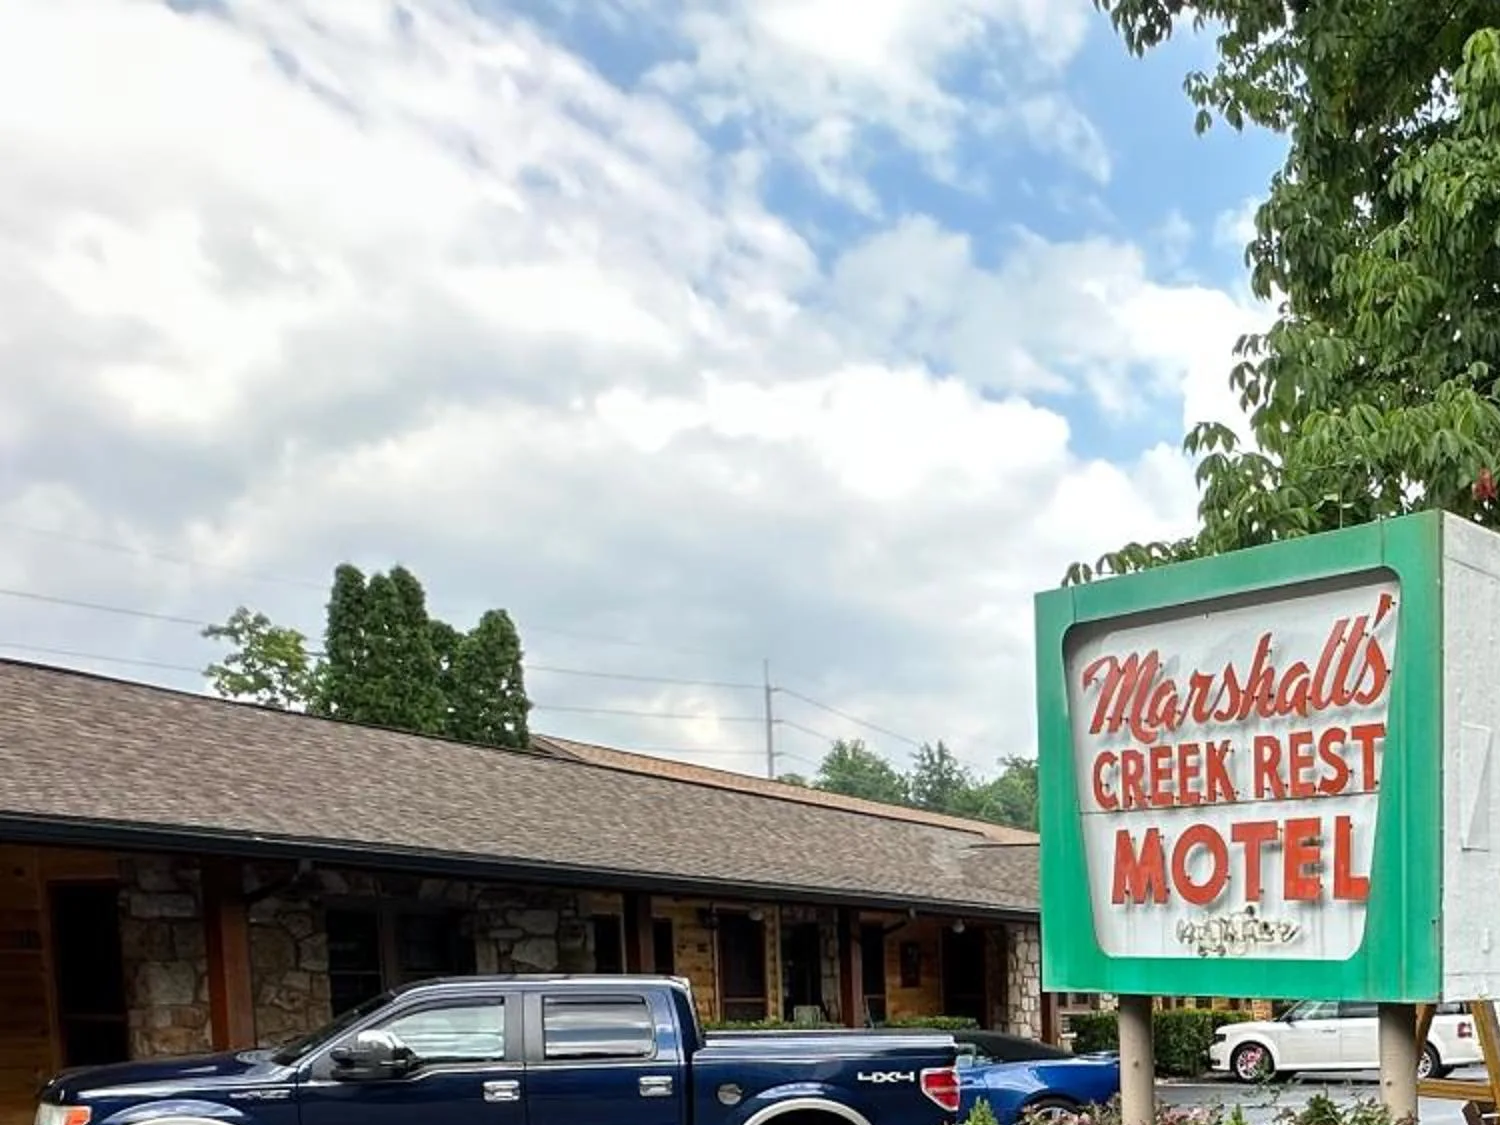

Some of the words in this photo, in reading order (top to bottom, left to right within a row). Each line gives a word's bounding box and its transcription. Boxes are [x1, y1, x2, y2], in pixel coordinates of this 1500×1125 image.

[1082, 593, 1393, 744] Marshall's
[1092, 738, 1236, 811] CREEK
[1252, 723, 1387, 799] REST
[1111, 815, 1370, 906] MOTEL
